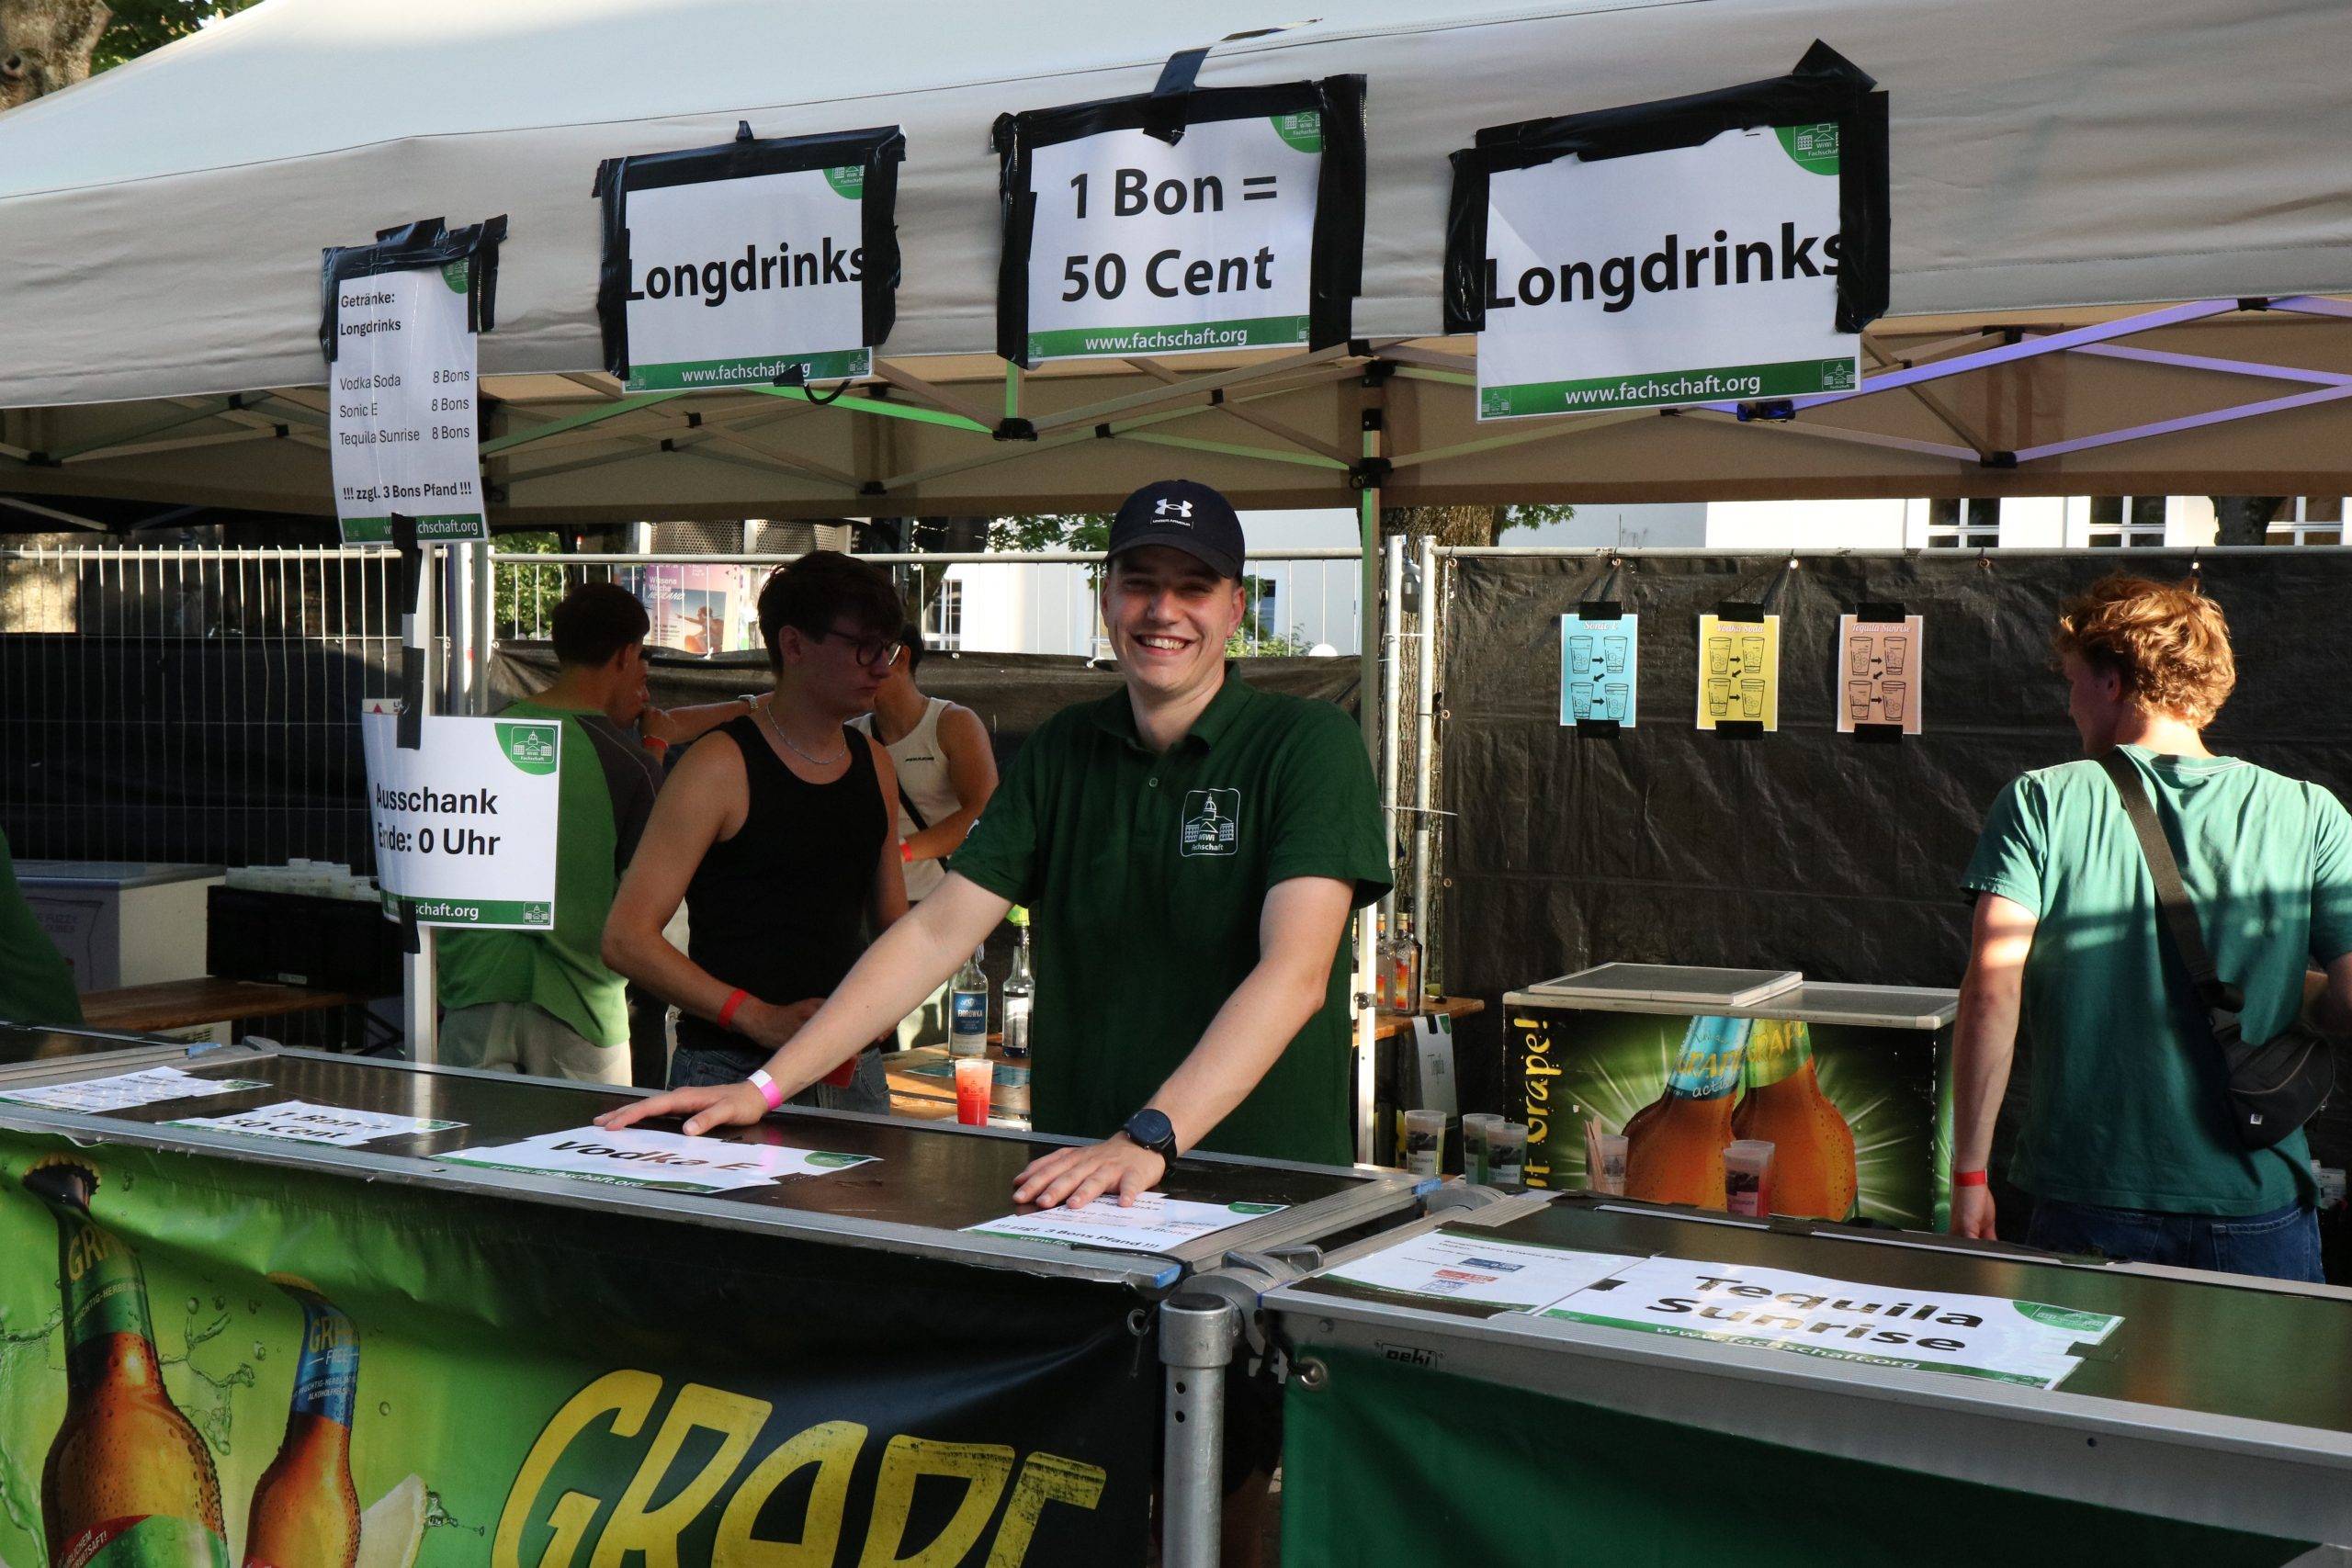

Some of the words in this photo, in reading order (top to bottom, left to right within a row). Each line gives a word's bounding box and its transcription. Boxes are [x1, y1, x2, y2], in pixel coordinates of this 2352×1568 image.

[1808, 149, 1838, 157] Fachschaf
[1070, 173, 1088, 220] 1
[1114, 168, 1224, 217] Bon
[1243, 175, 1277, 201] =
[627, 237, 865, 307] Longdrinks
[1061, 253, 1126, 302] 50
[1146, 245, 1274, 298] Cent
[1486, 221, 1840, 313] Longdrinks
[341, 292, 395, 309] Getränke:
[340, 320, 401, 337] Longdrinks
[1085, 327, 1248, 351] www.fachschaft.org
[339, 377, 371, 391] Vodka
[373, 374, 401, 389] Soda
[433, 369, 440, 384] 8
[442, 369, 469, 383] Bons
[682, 361, 810, 382] www.fachschaftg
[1565, 373, 1761, 405] www.fachschaft.org
[339, 403, 368, 419] Sonic
[370, 402, 379, 416] E
[431, 397, 438, 412] 8
[441, 396, 469, 411] Bons
[339, 431, 377, 447] Tequila
[379, 428, 420, 443] Sunrise
[432, 425, 439, 440] 8
[442, 424, 469, 440] Bons
[343, 486, 355, 501] !!!
[356, 484, 381, 502] zzgl.
[383, 484, 390, 498] 3
[392, 483, 421, 498] Bons
[423, 481, 458, 498] Pfand
[459, 480, 471, 494] !!!
[376, 783, 499, 815] Ausschank
[378, 822, 413, 852] Ende:
[418, 828, 435, 853] 0
[443, 828, 501, 855] Uhr
[218, 1119, 271, 1128] 50
[267, 1123, 353, 1140] Cent
[292, 1114, 360, 1127] Bon
[549, 1141, 710, 1166] Vodka
[1056, 1229, 1093, 1239] Bons
[1096, 1235, 1142, 1247] Pfand
[1695, 1275, 1984, 1329] Tequila
[1645, 1297, 1966, 1353] Sunrise
[1657, 1327, 1919, 1369] www.fachschaft.org
